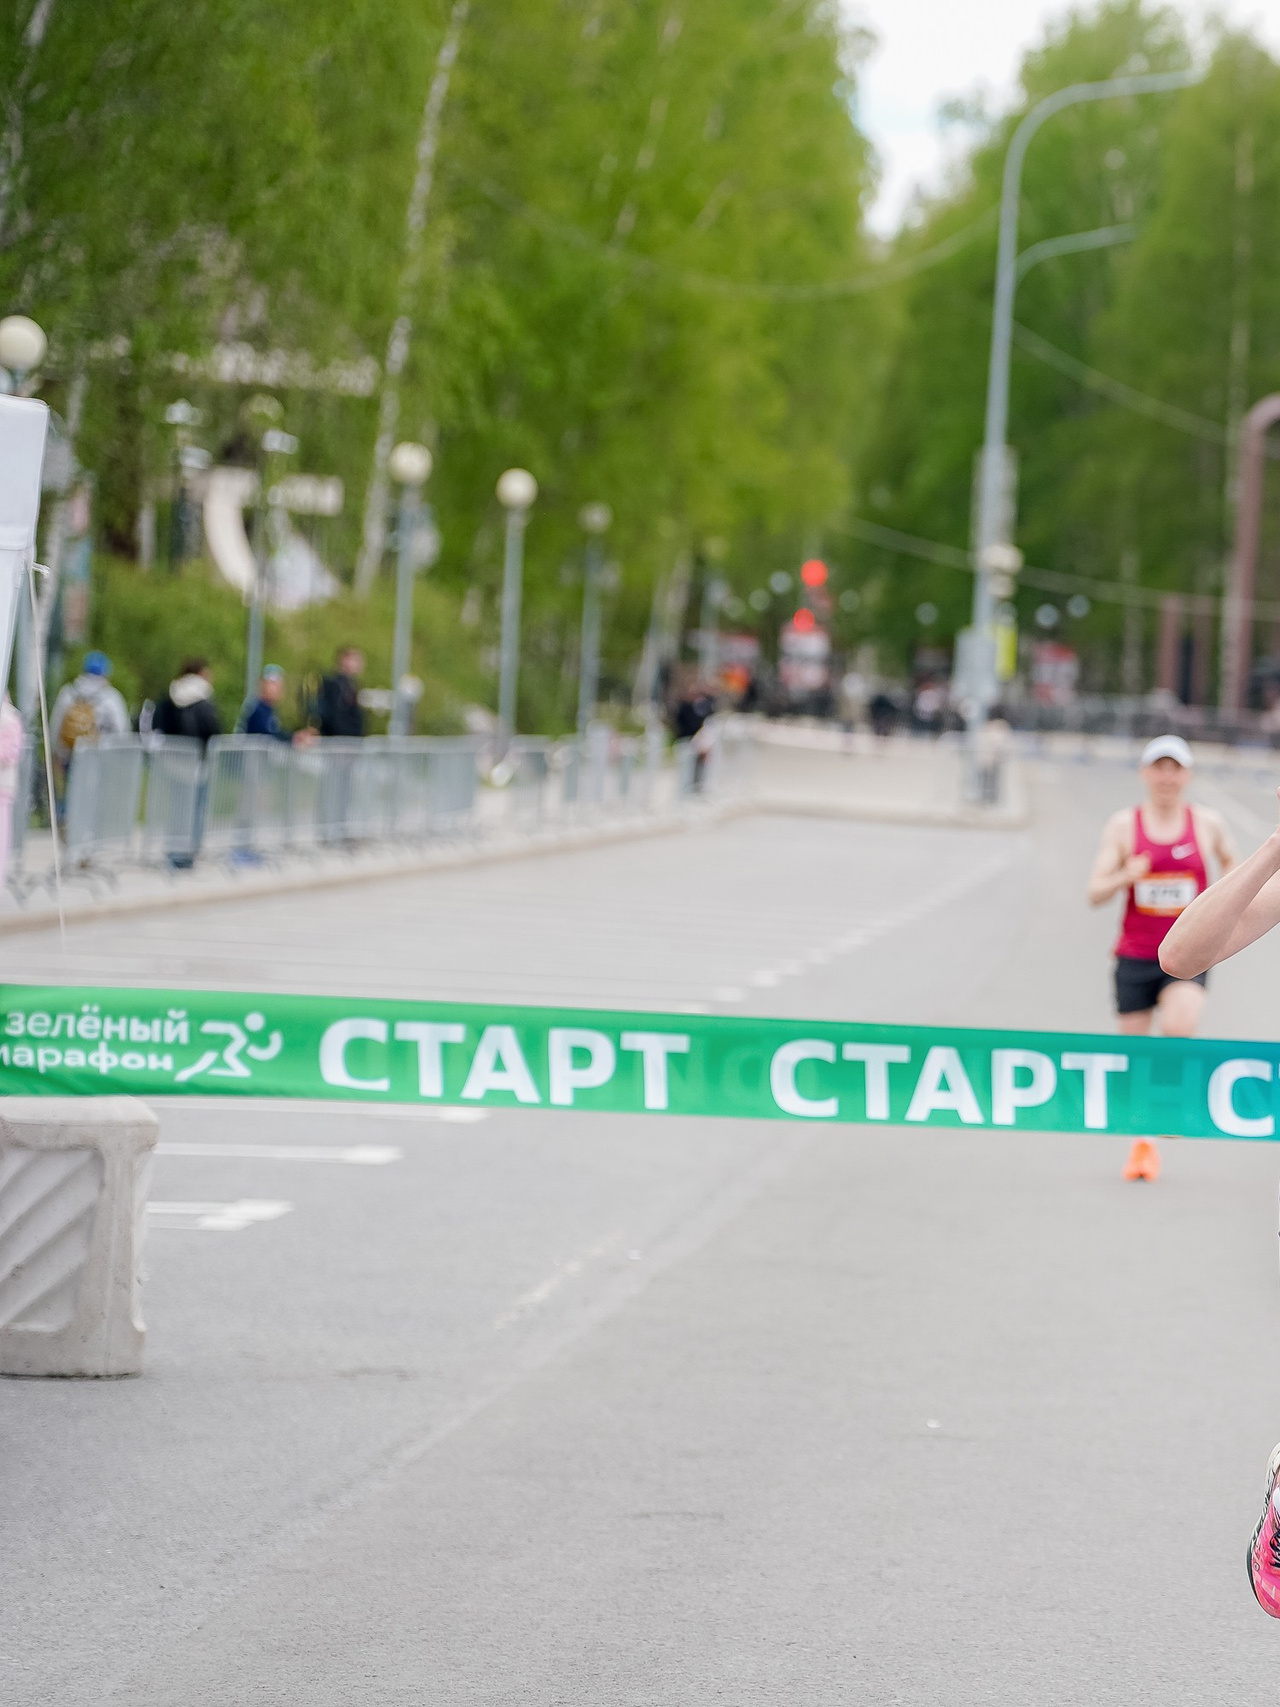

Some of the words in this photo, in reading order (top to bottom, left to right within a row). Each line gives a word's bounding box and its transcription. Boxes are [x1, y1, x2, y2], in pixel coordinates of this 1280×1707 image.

[5, 1003, 190, 1045] зелёный
[319, 1017, 690, 1111] СТАРТ
[769, 1039, 1128, 1130] СТАРТ
